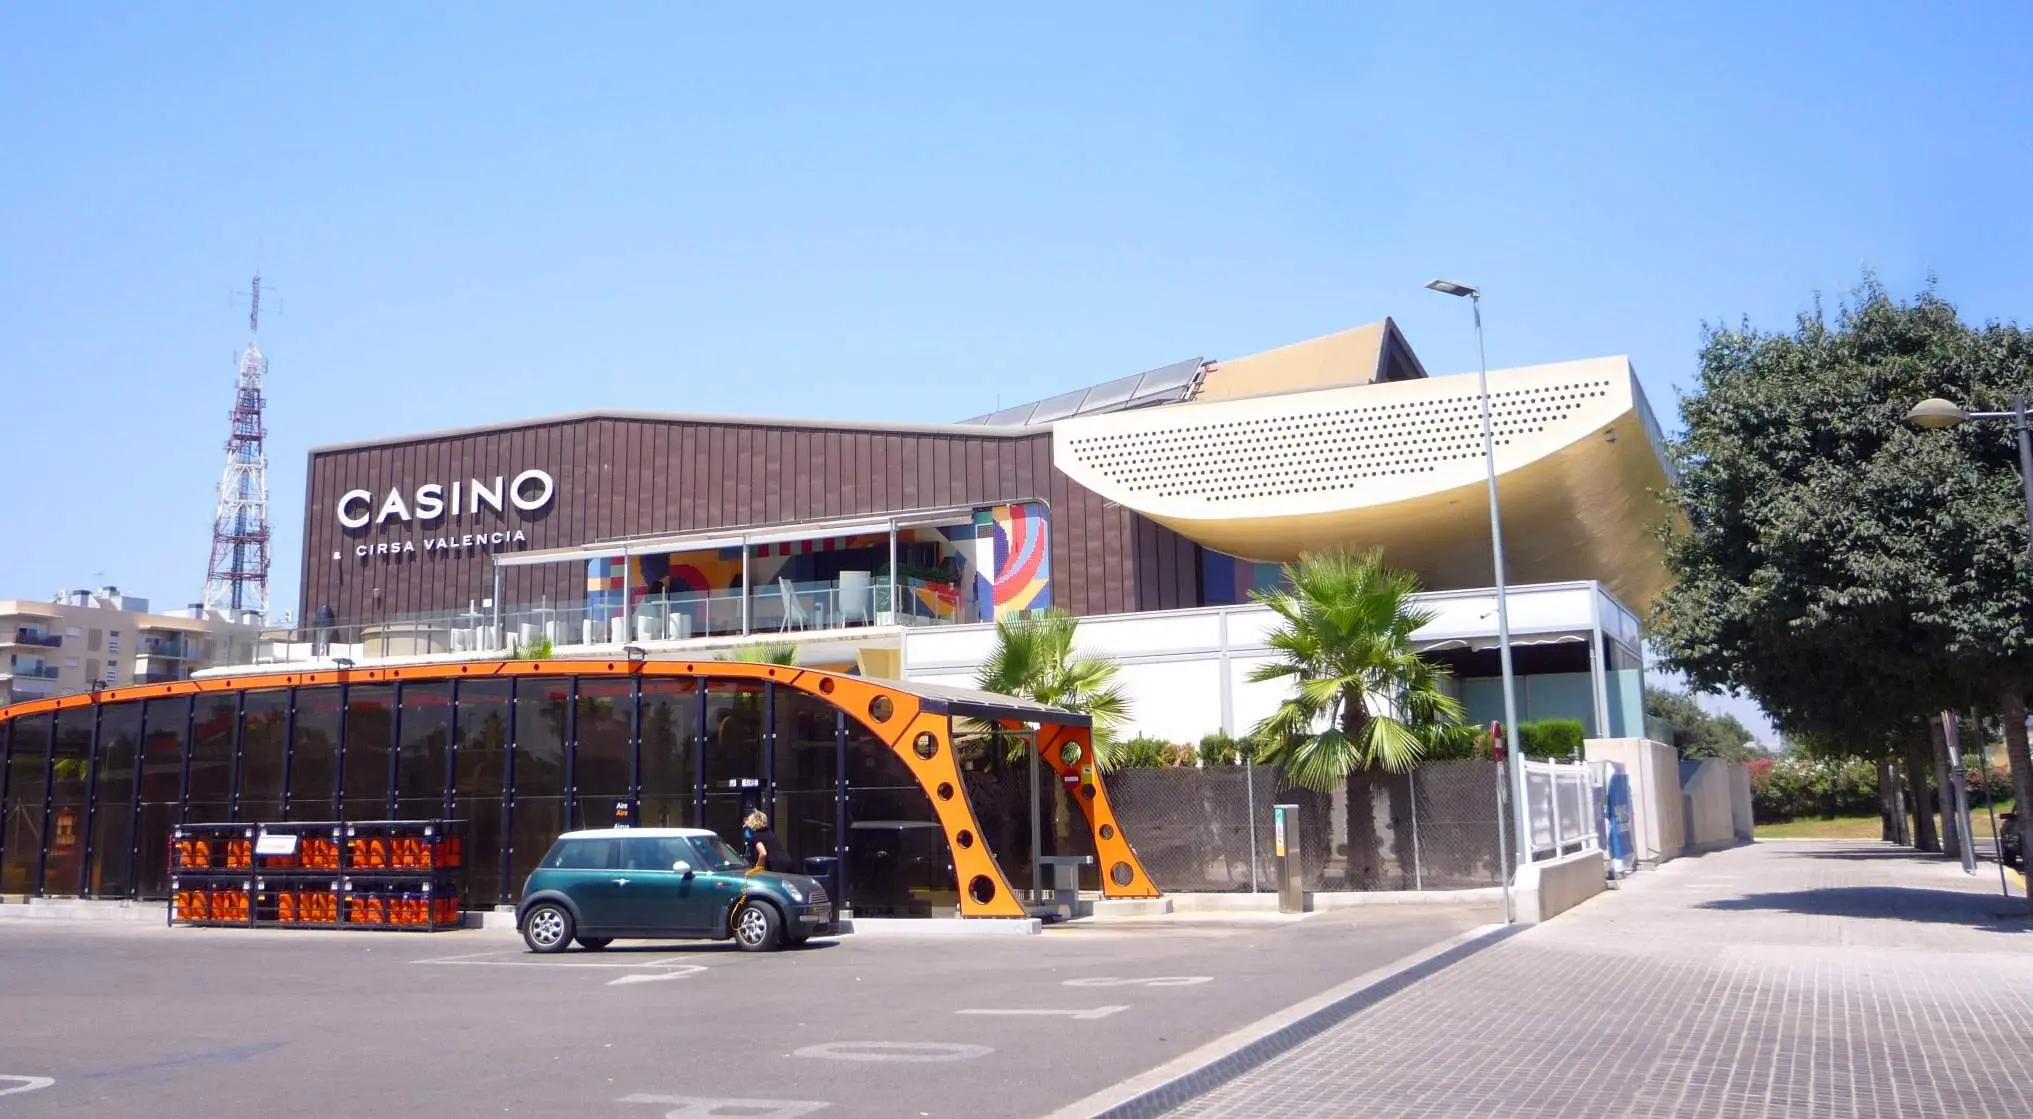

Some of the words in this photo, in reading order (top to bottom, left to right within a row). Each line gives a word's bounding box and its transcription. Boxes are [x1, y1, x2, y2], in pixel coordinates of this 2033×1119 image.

[337, 469, 553, 528] CASINO
[356, 541, 415, 556] CIRSA
[423, 530, 526, 550] VALENCIA
